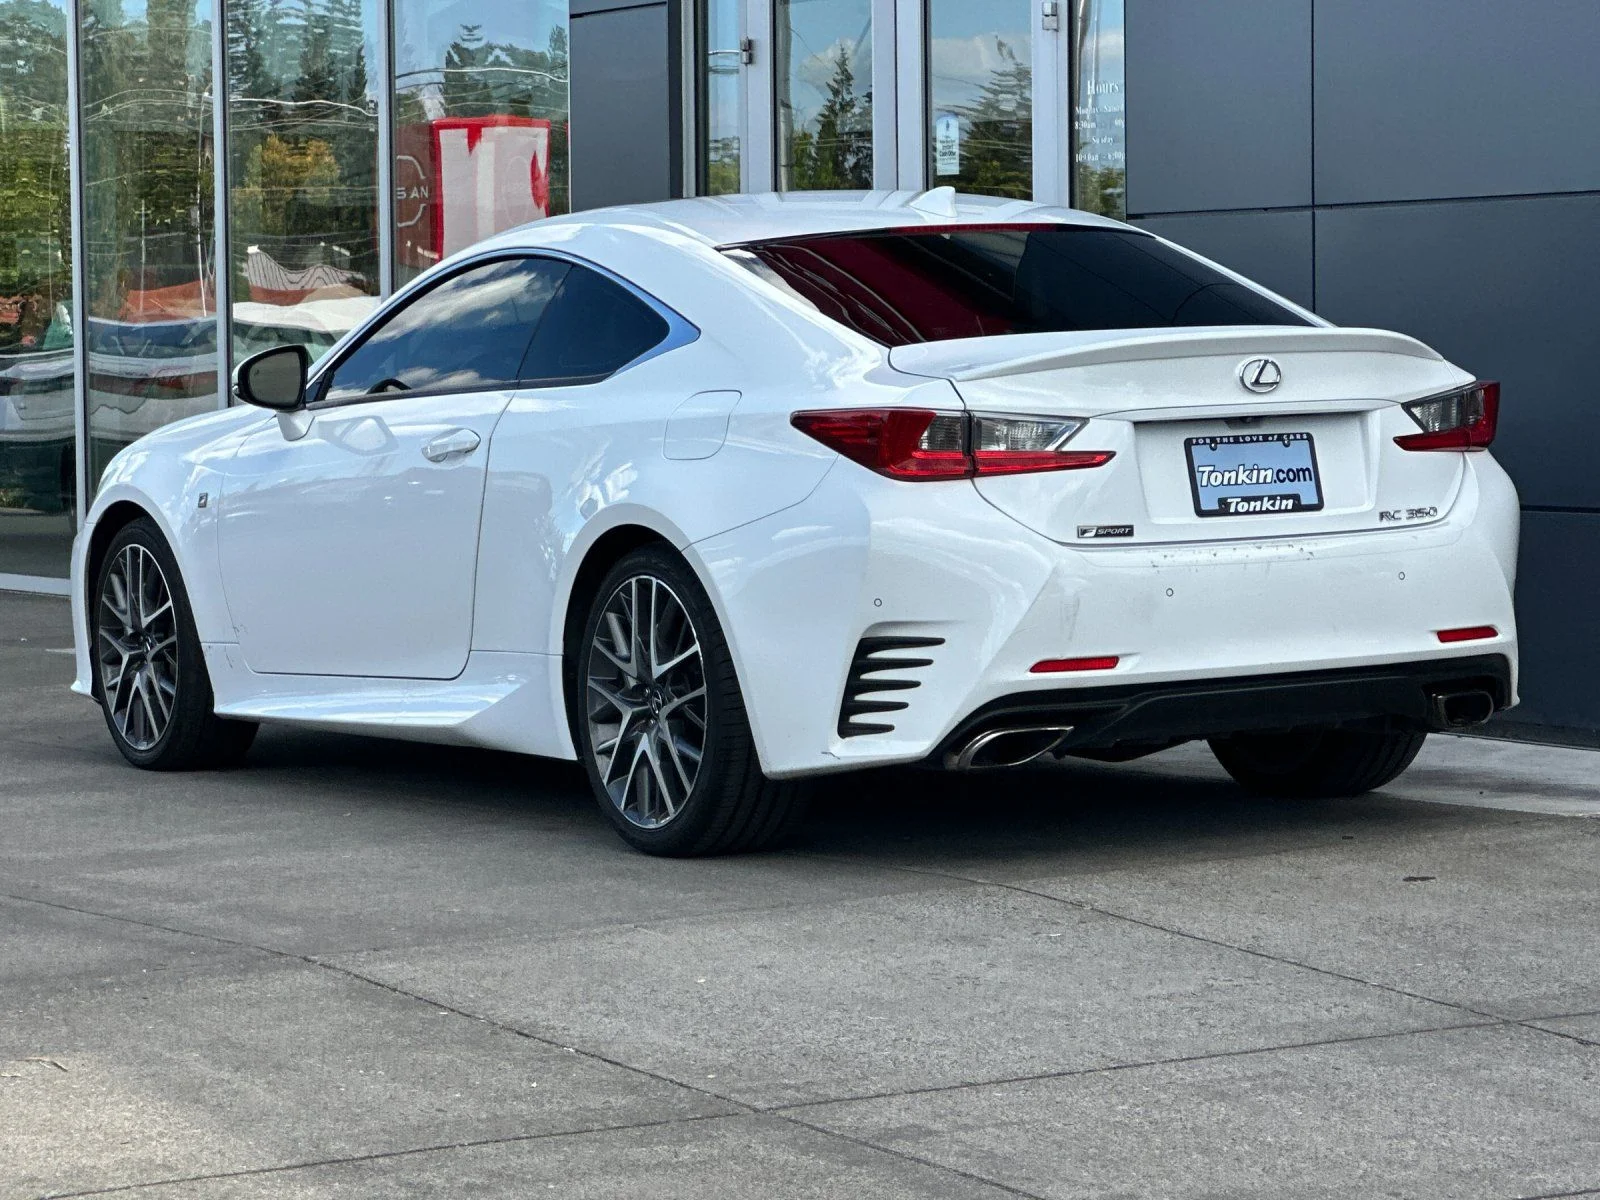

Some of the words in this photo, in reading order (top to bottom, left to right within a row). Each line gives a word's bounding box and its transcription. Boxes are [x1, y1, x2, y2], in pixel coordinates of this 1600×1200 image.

[1087, 80, 1119, 95] Hours
[1198, 464, 1313, 488] Tonkin.com
[1226, 496, 1294, 513] Tonkin
[1379, 510, 1402, 522] RC
[1405, 506, 1438, 520] 350
[1097, 527, 1132, 535] SPORT
